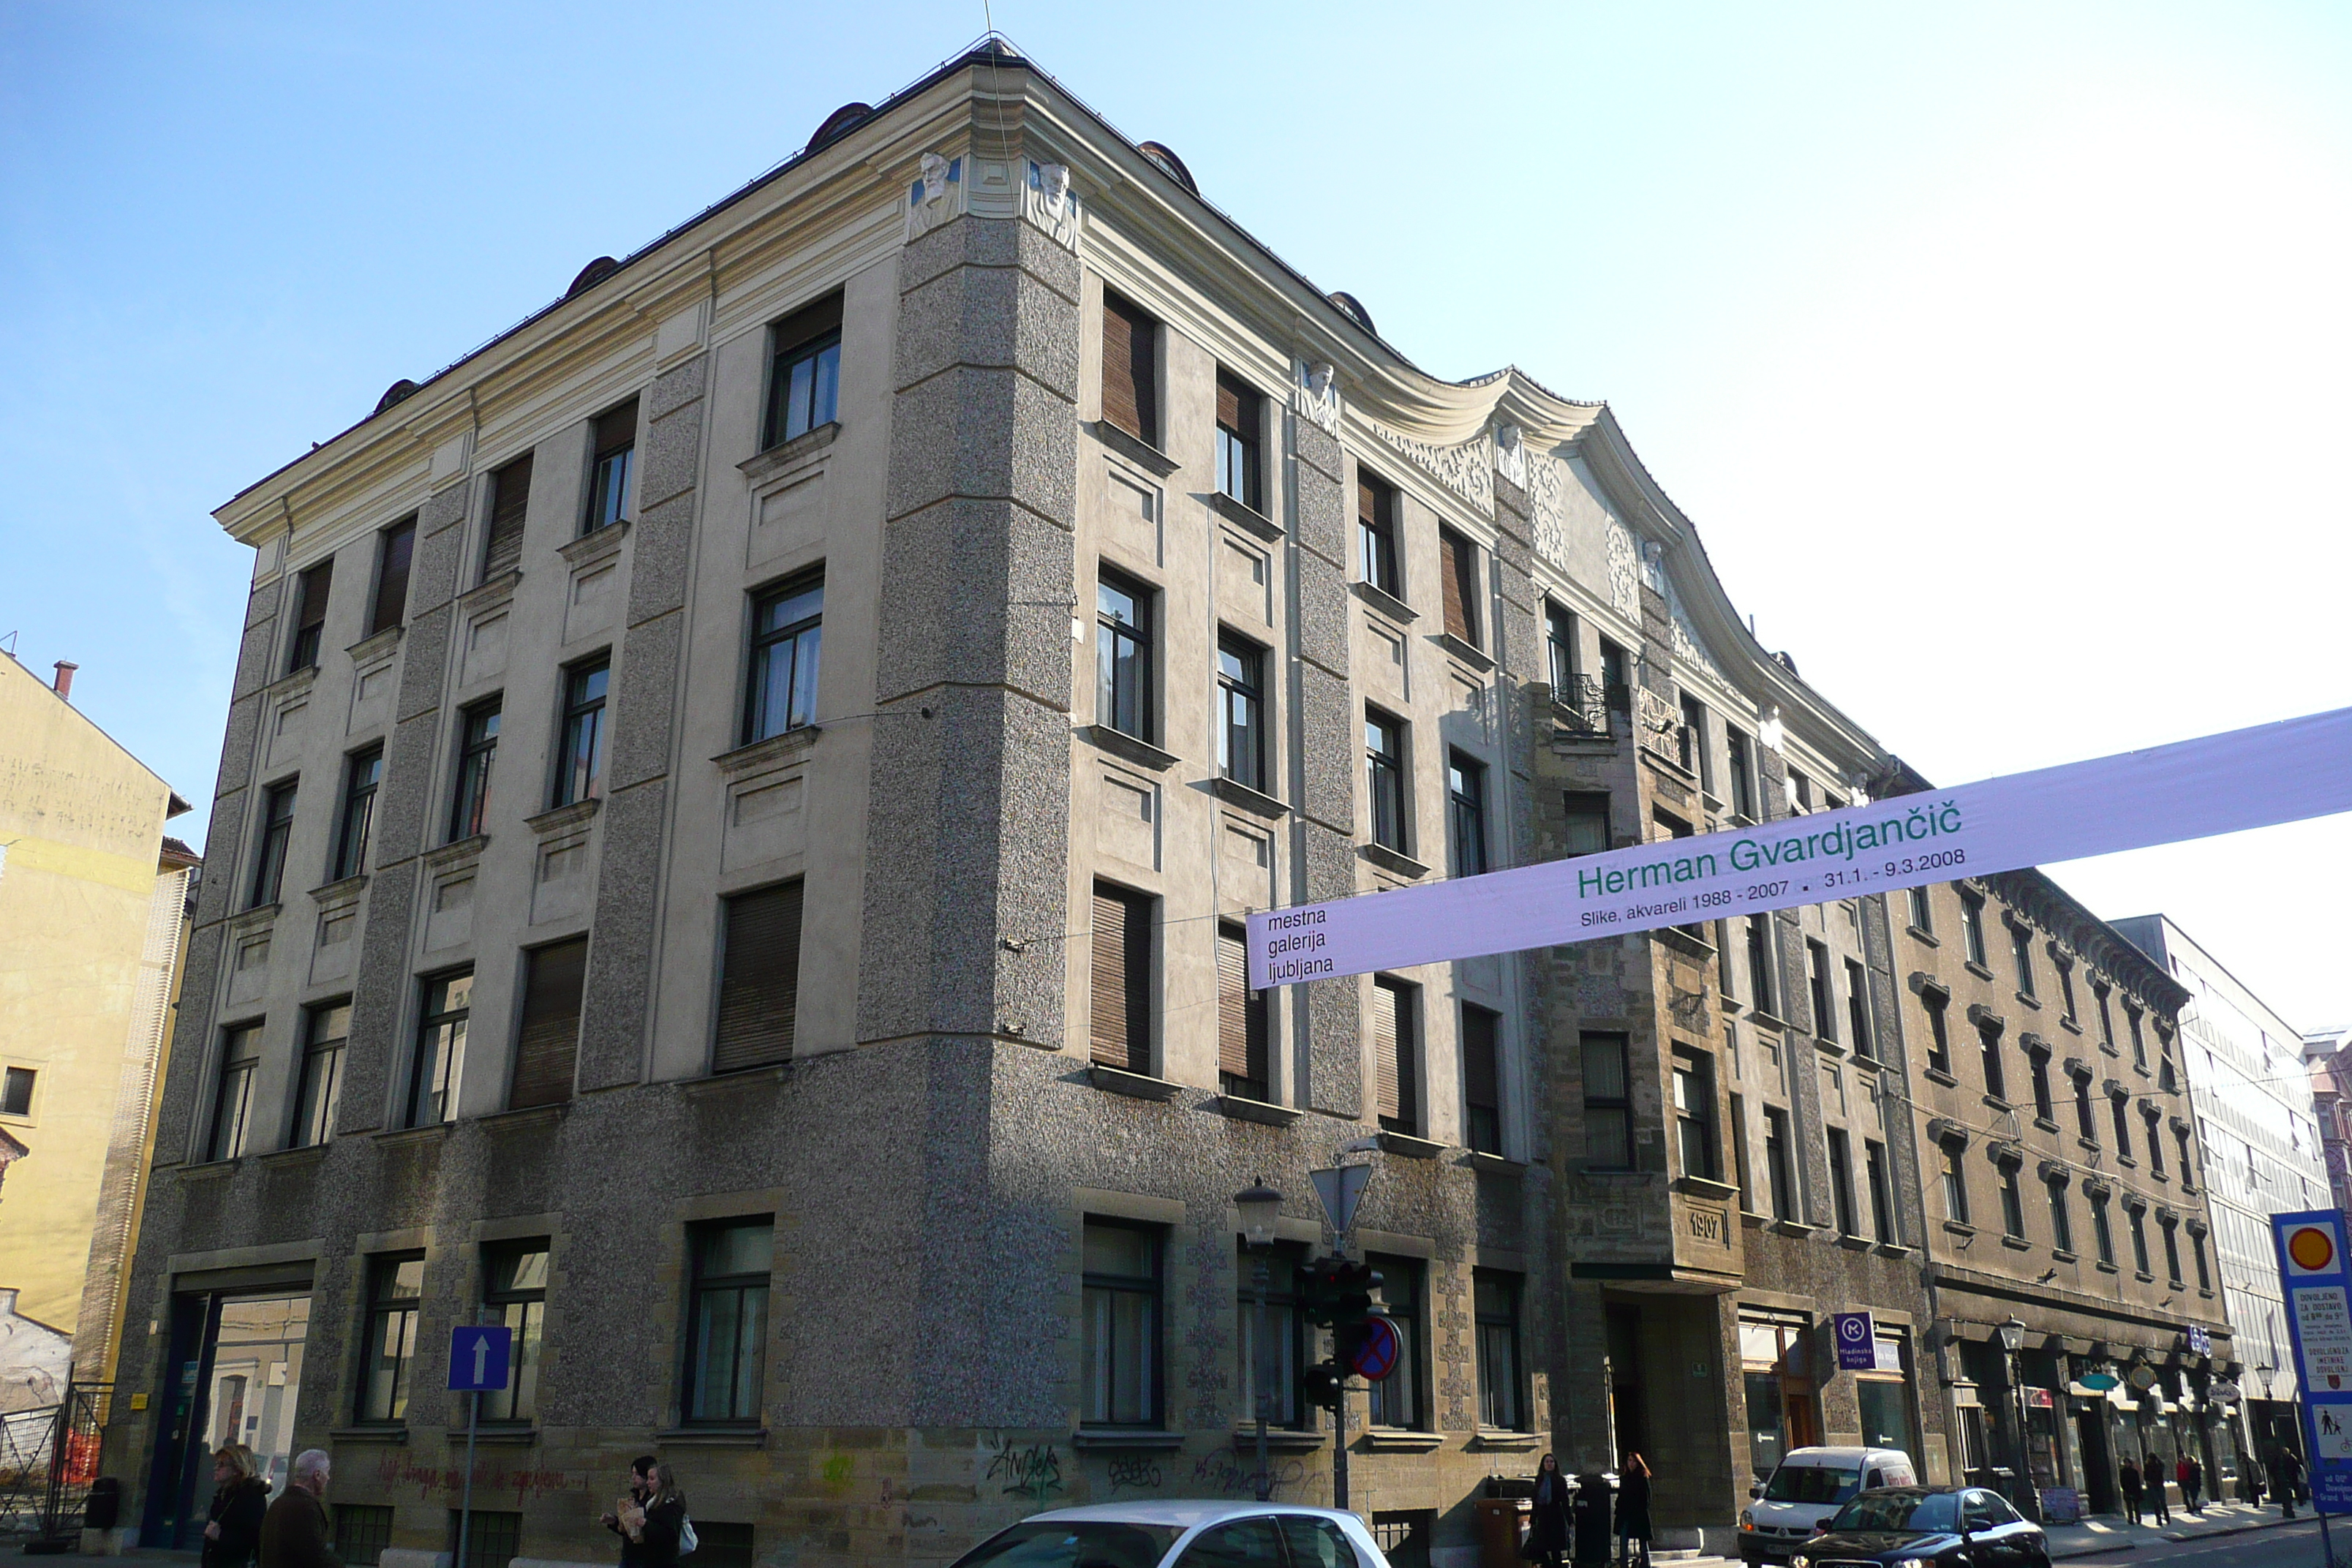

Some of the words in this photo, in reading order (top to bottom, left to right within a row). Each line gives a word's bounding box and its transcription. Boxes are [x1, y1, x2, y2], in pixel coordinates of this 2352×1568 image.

[1578, 853, 1716, 899] Herman
[1730, 799, 1962, 872] Gvardjančič
[1824, 867, 1869, 888] 31.1.
[1884, 848, 1966, 877] 9.3.2008
[1581, 911, 1621, 927] Slike,
[1627, 897, 1686, 920] akvareli
[1692, 889, 1732, 909] 1988
[1748, 881, 1789, 900] 2007
[1268, 909, 1327, 932] mestna
[1267, 930, 1326, 959] galerija
[1269, 957, 1334, 984] ljubljana
[1839, 1346, 1872, 1355] Mladinska
[1846, 1356, 1867, 1365] knjiga
